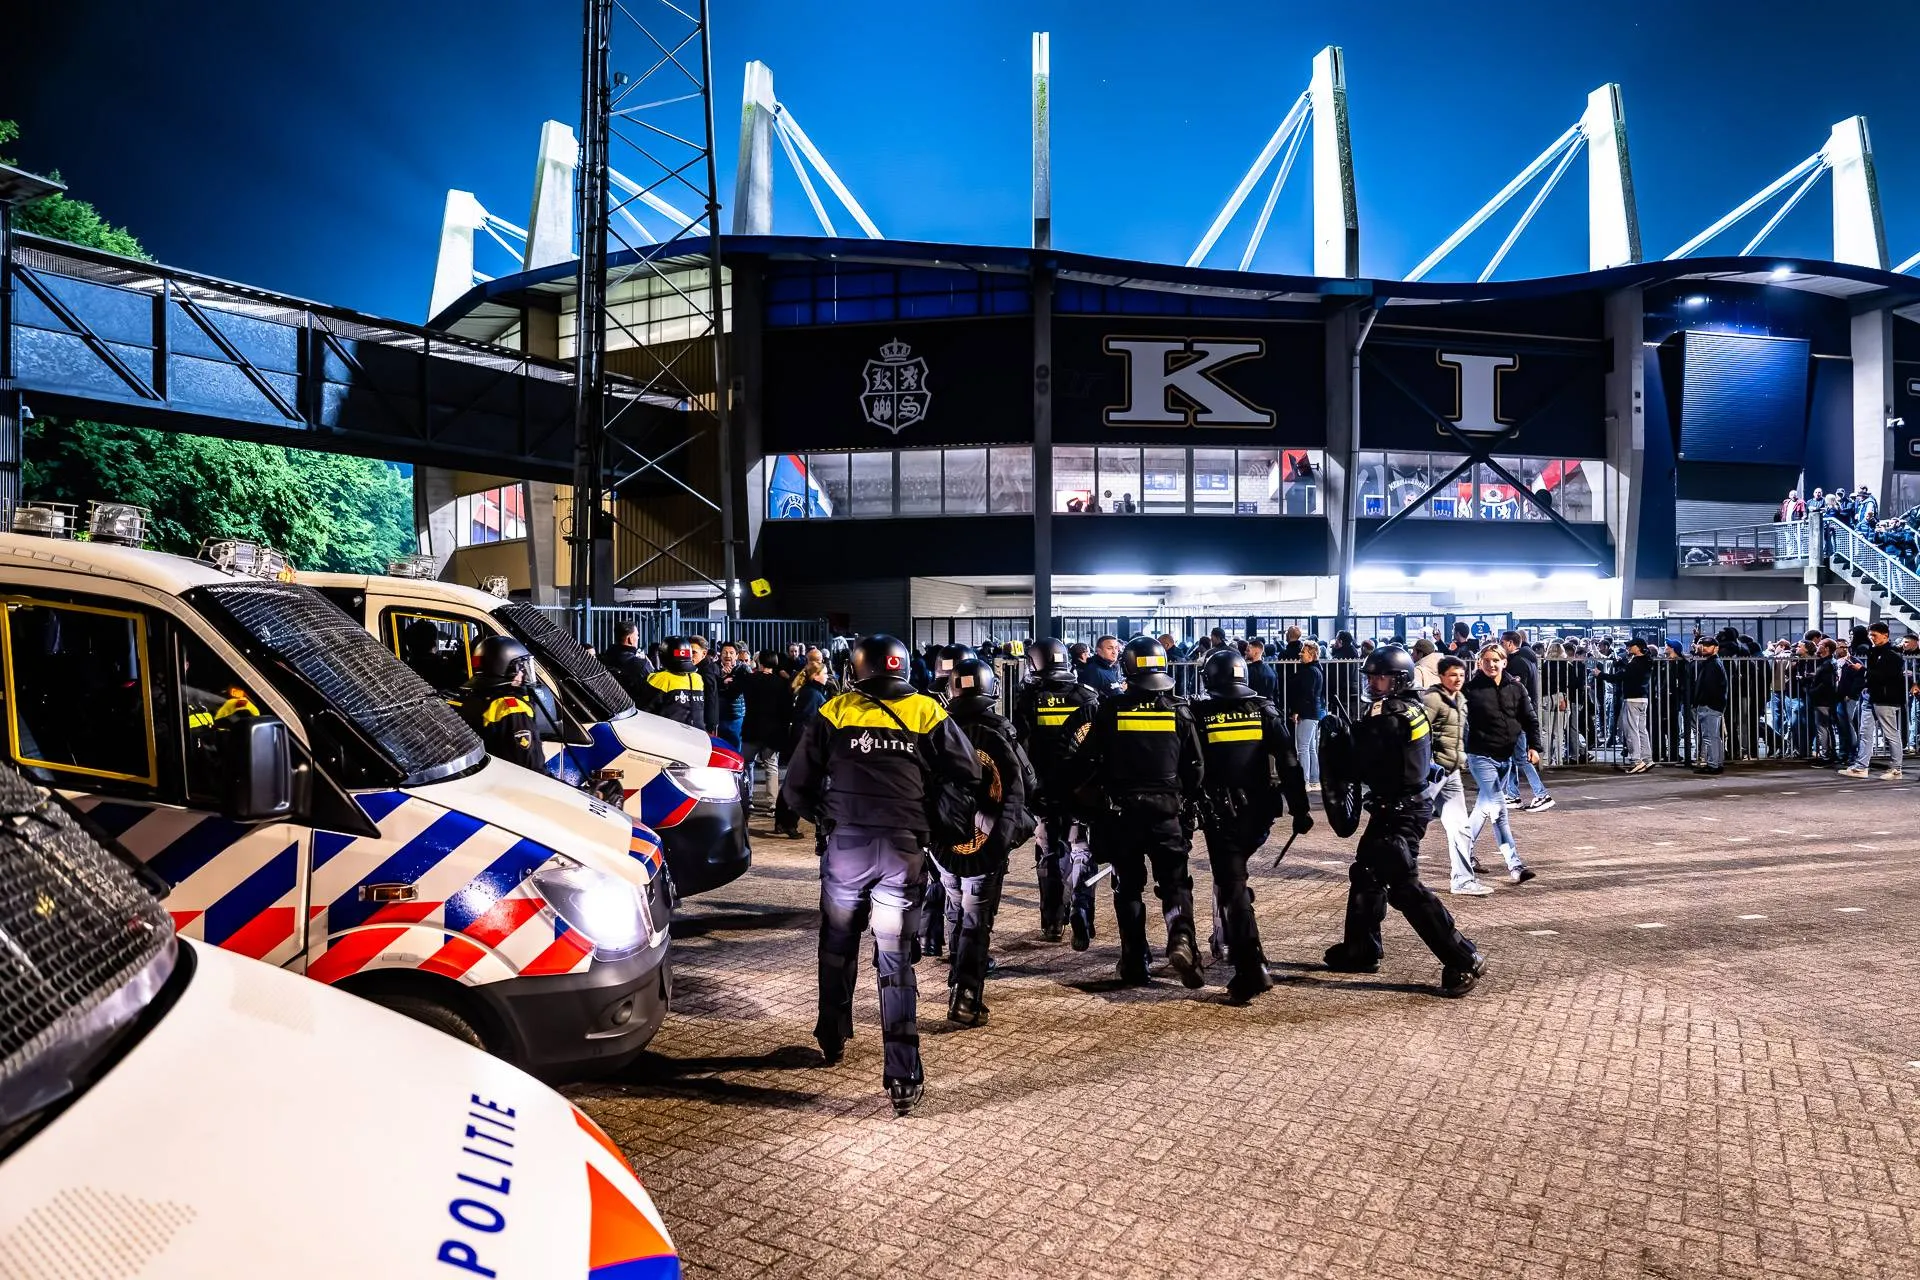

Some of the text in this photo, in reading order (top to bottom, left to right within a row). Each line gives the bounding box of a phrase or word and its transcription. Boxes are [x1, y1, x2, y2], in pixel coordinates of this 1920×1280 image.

[674, 691, 704, 703] POLTIE
[850, 730, 914, 753] POLITIE
[437, 1093, 515, 1279] POLITIE
